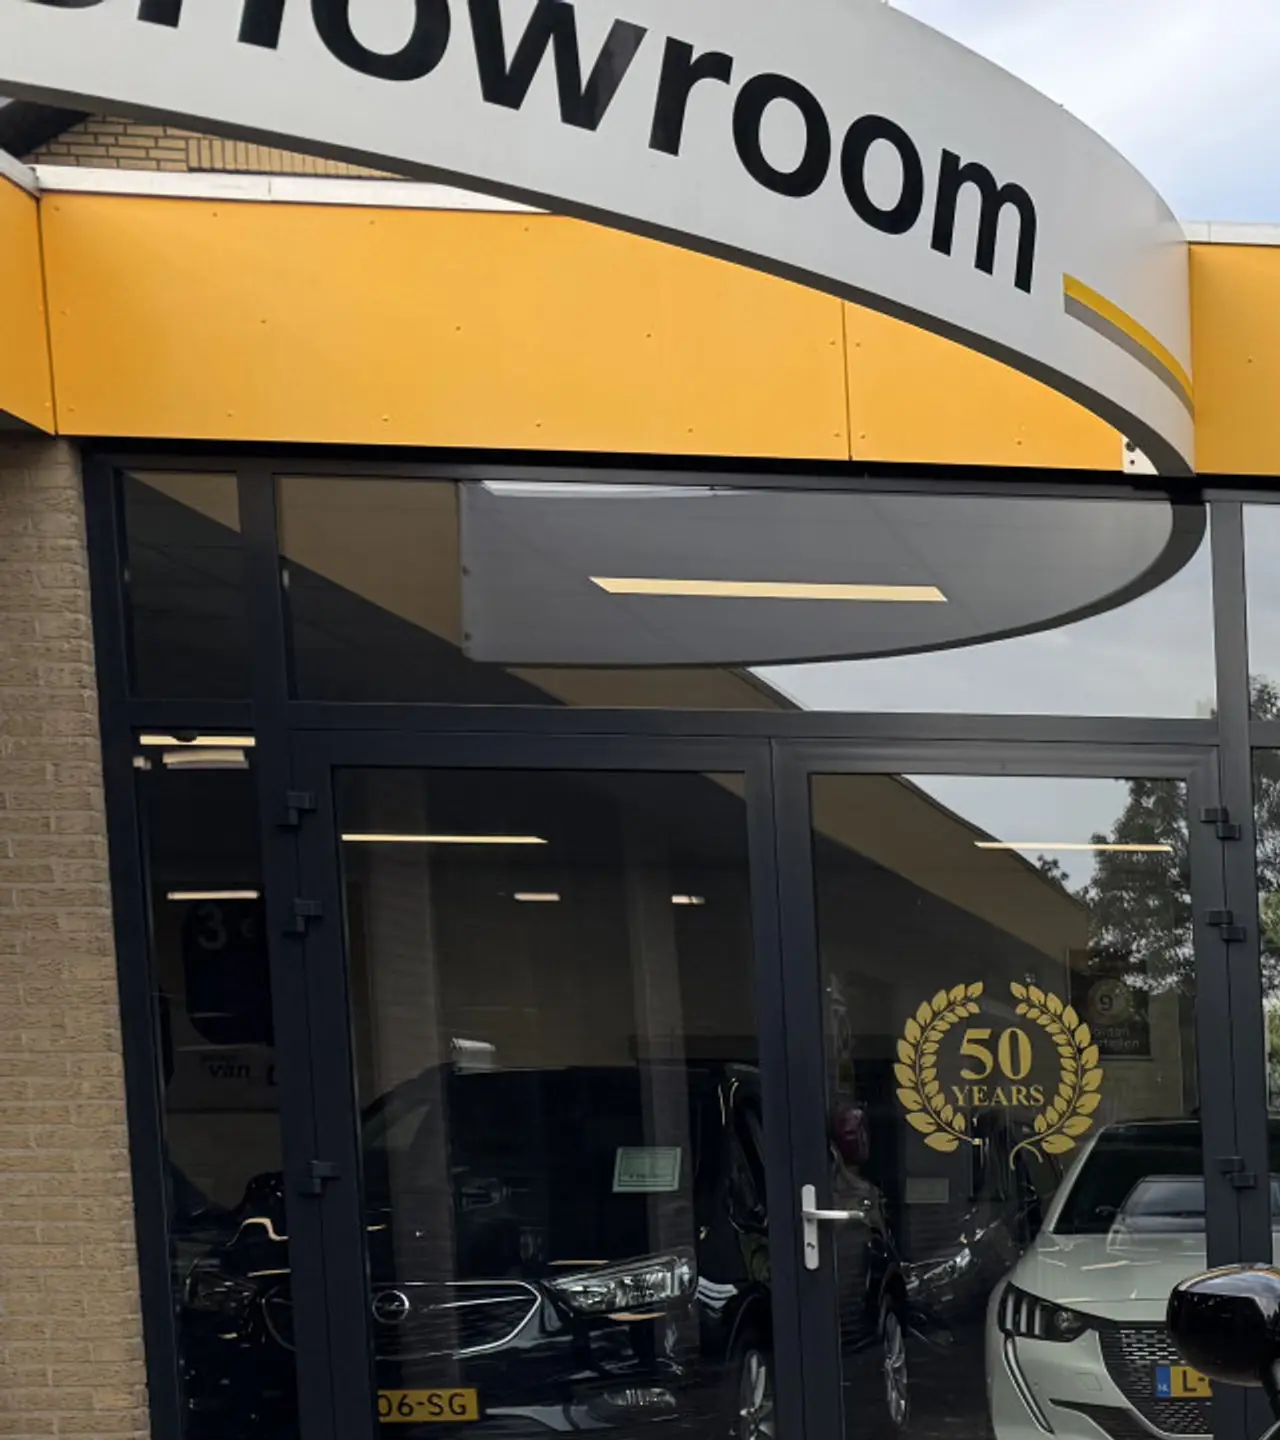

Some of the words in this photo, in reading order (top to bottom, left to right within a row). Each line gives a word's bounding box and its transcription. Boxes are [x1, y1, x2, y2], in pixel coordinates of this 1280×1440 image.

[14, 0, 1037, 294] owroom
[959, 1027, 1033, 1080] 50
[951, 1085, 1046, 1107] YEARS
